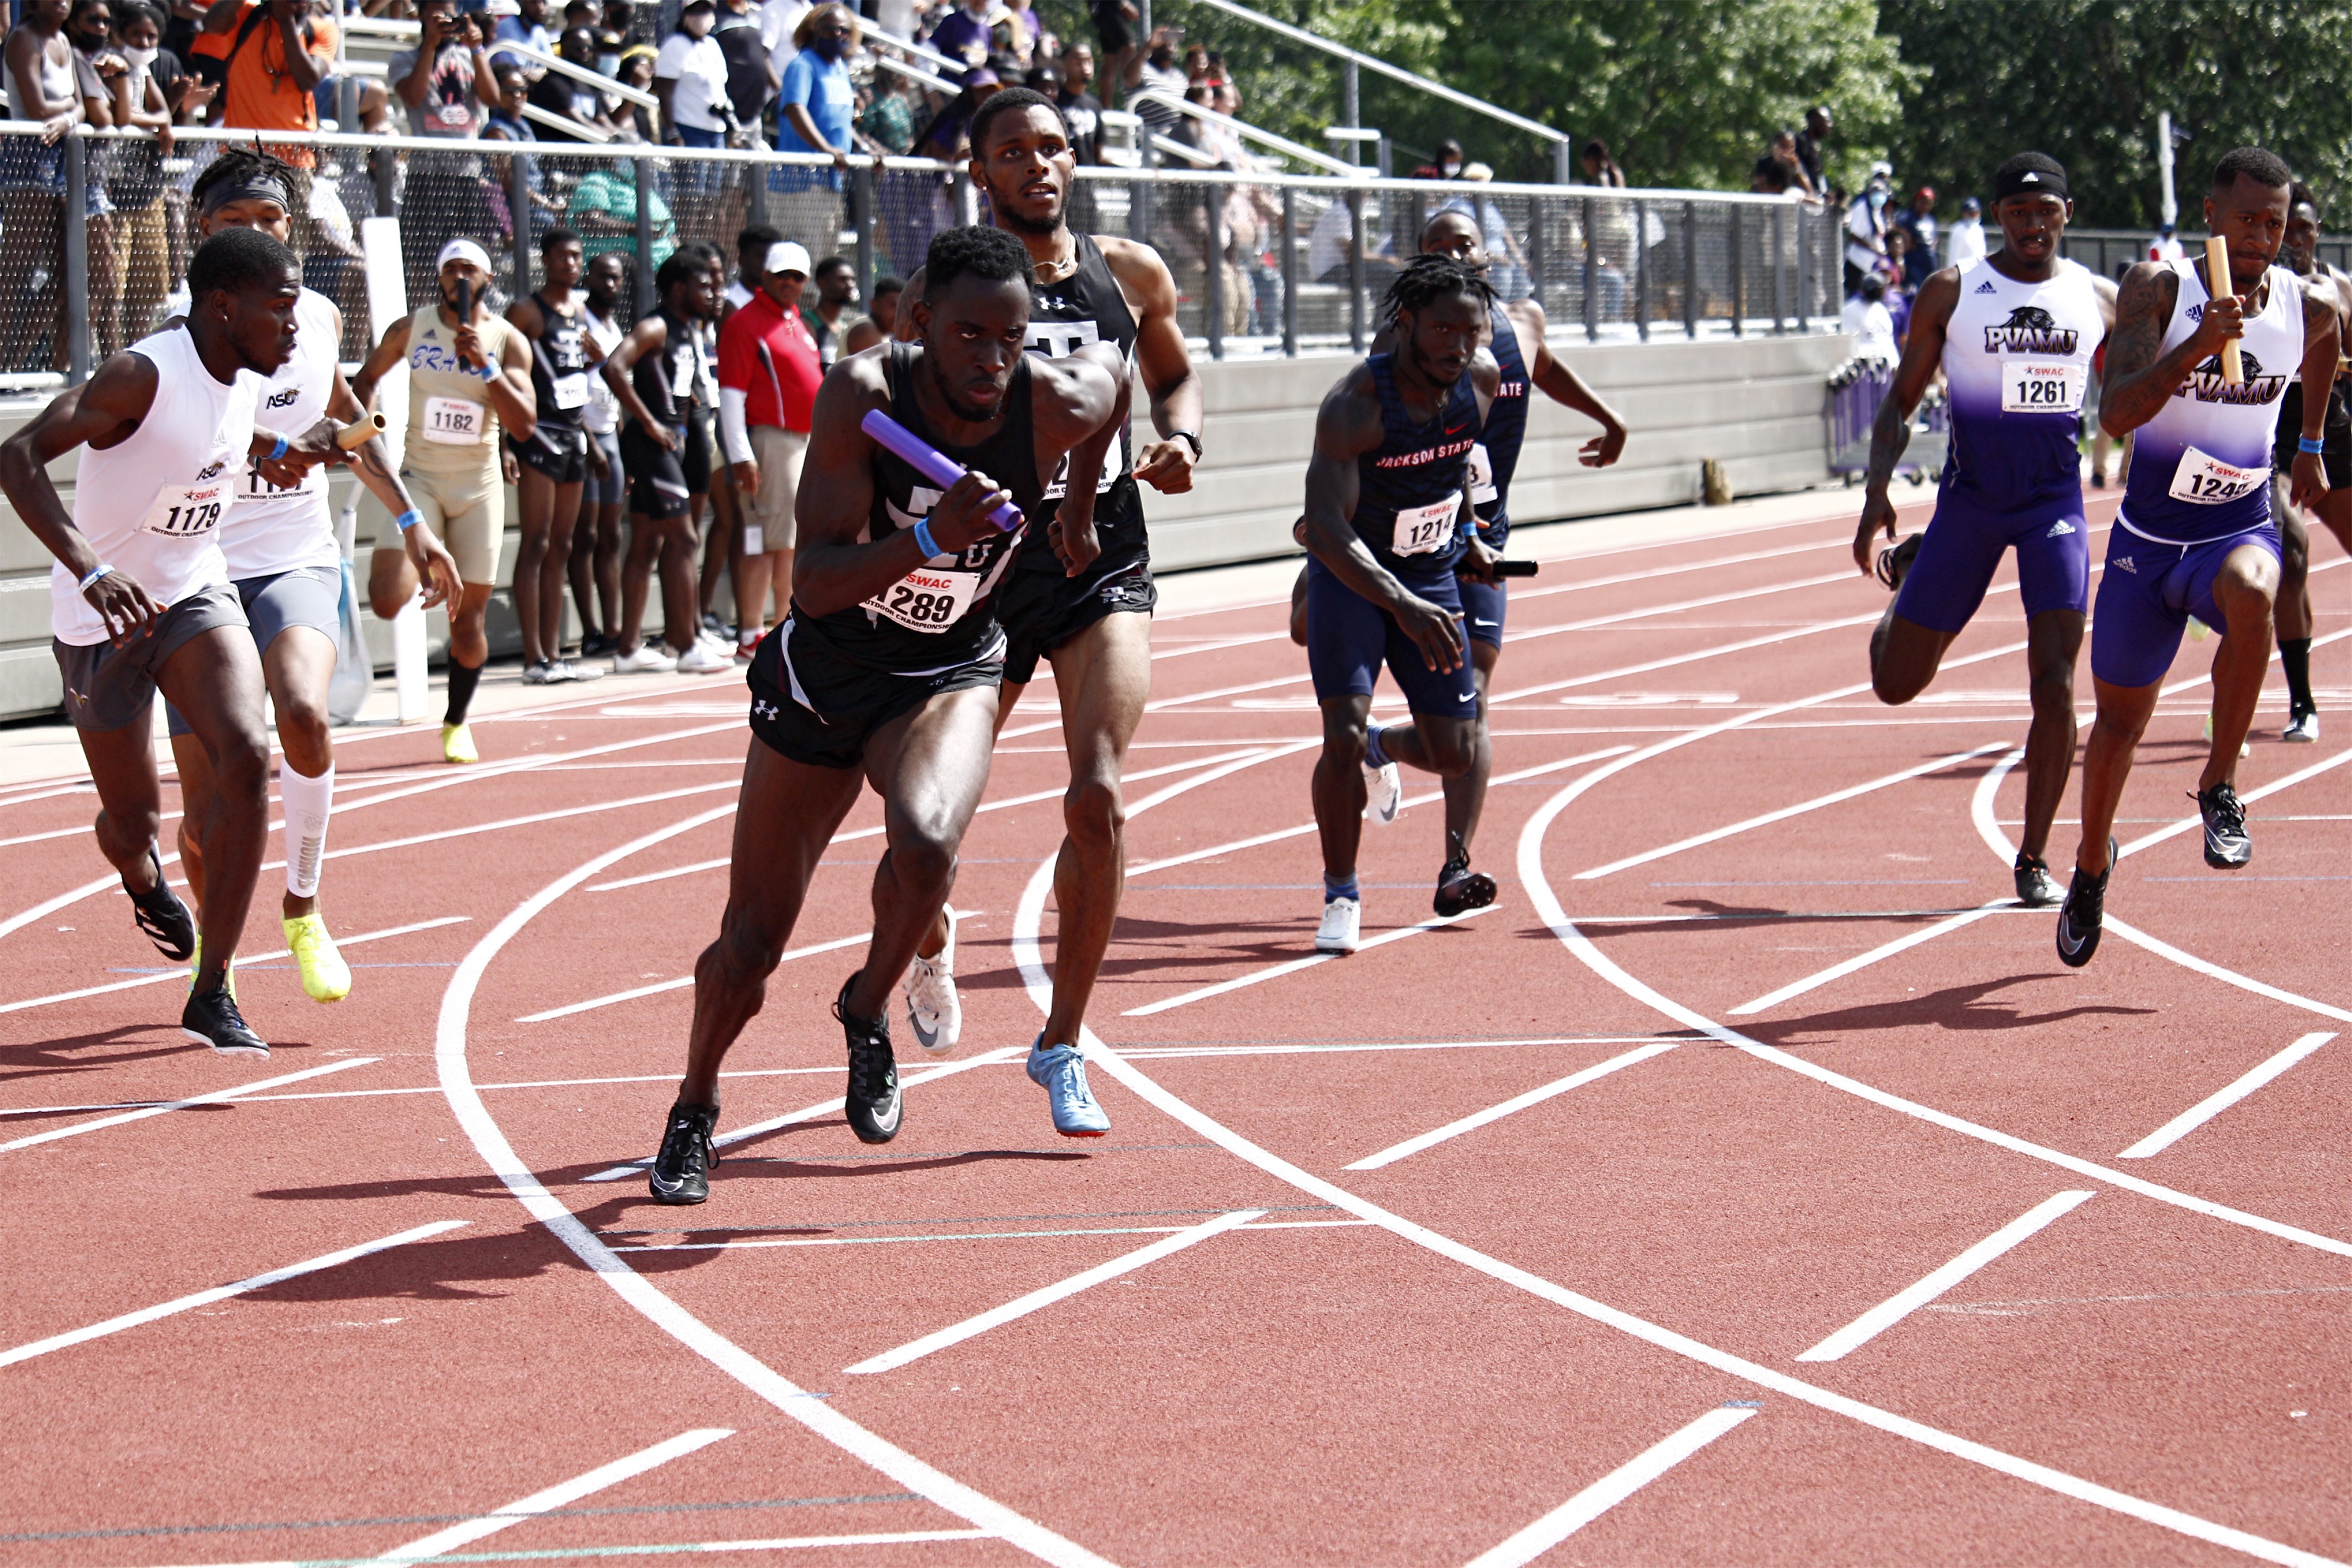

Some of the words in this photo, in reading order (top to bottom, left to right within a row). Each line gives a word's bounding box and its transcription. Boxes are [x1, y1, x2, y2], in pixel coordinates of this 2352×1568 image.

[1985, 326, 2078, 357] PVAMU
[2034, 368, 2064, 376] SWAC
[1495, 383, 1522, 396] ATE
[2017, 381, 2066, 404] 1261
[2173, 370, 2286, 405] PVAMU
[435, 412, 473, 432] 1182
[1376, 448, 1435, 469] JACKSON
[1438, 439, 1474, 458] STATE
[2216, 468, 2250, 481] SWAC
[194, 488, 220, 501] SWAC
[269, 491, 313, 500] CHAMPIONSHIP
[2178, 492, 2206, 502] OUTDOOR
[166, 502, 221, 531] 1179
[1427, 504, 1452, 518] SWAC
[151, 527, 180, 537] OUTDOOR
[1411, 512, 1453, 545] 1214
[906, 574, 952, 589] SWAC
[865, 599, 895, 616] UTDOOR
[896, 614, 952, 630] CHAMPIONSHI
